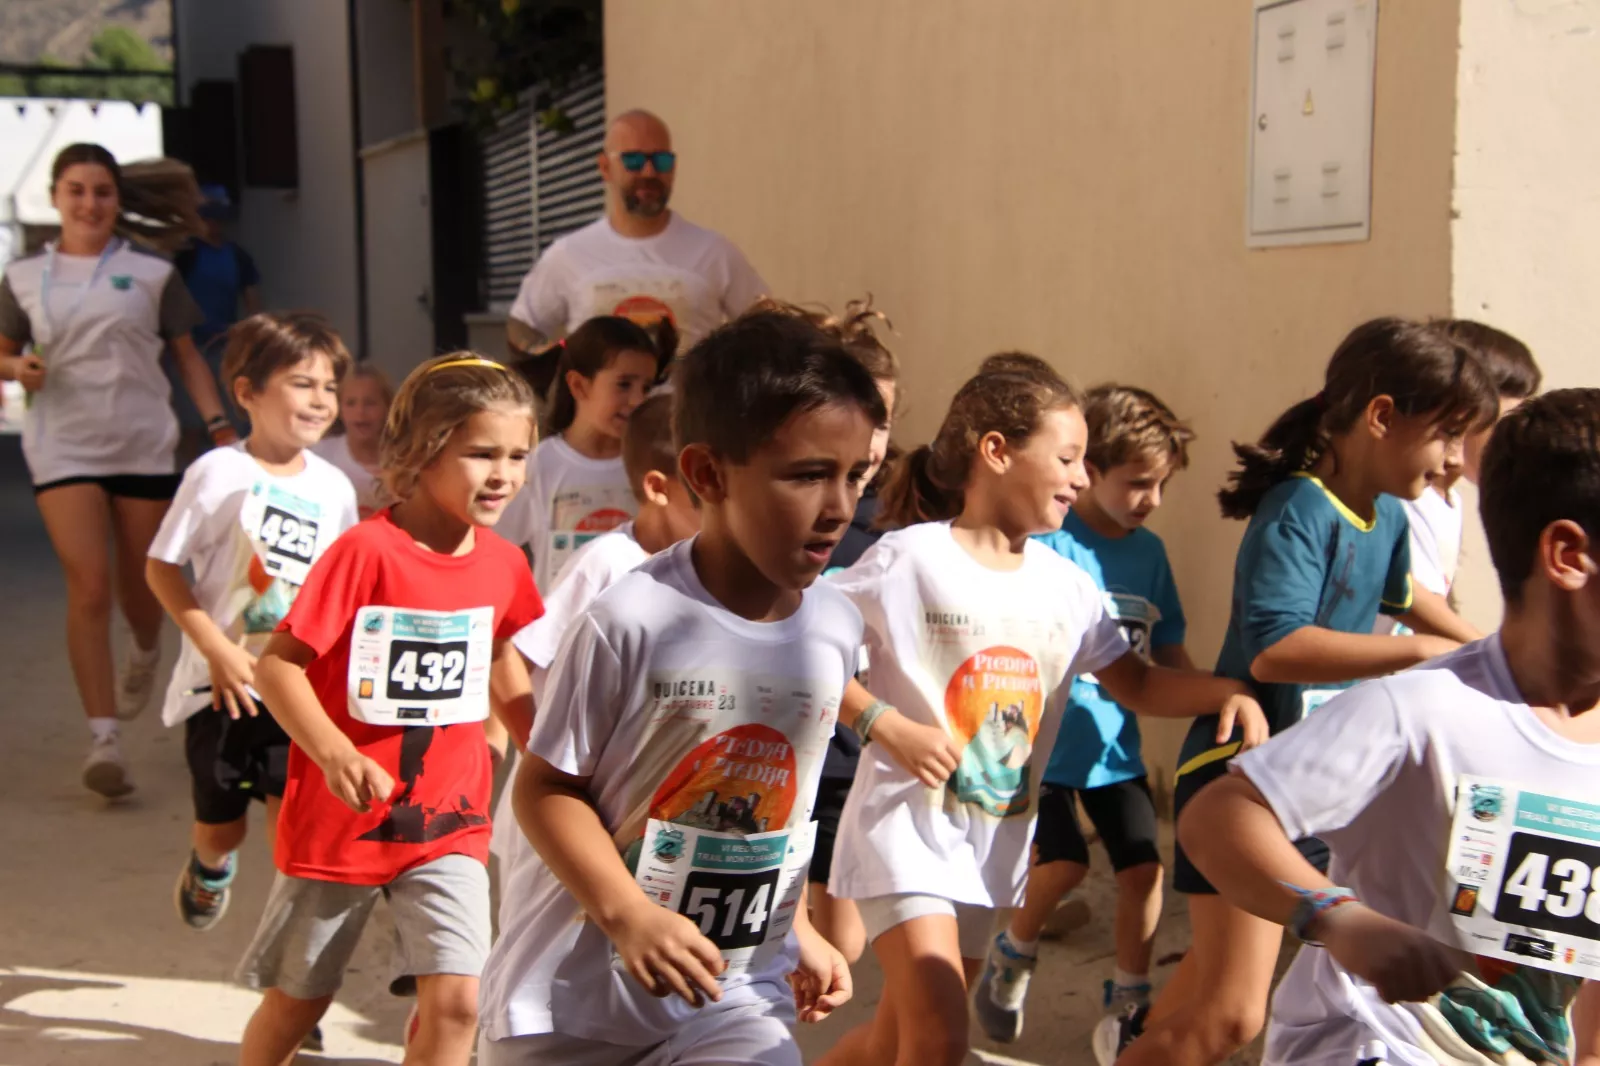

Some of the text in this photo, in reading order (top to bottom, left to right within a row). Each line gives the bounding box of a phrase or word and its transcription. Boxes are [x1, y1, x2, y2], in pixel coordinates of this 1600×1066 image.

[260, 513, 317, 558] 425
[390, 650, 466, 692] 432
[654, 680, 716, 699] QUICENA
[718, 695, 736, 710] 23
[685, 884, 771, 937] 514
